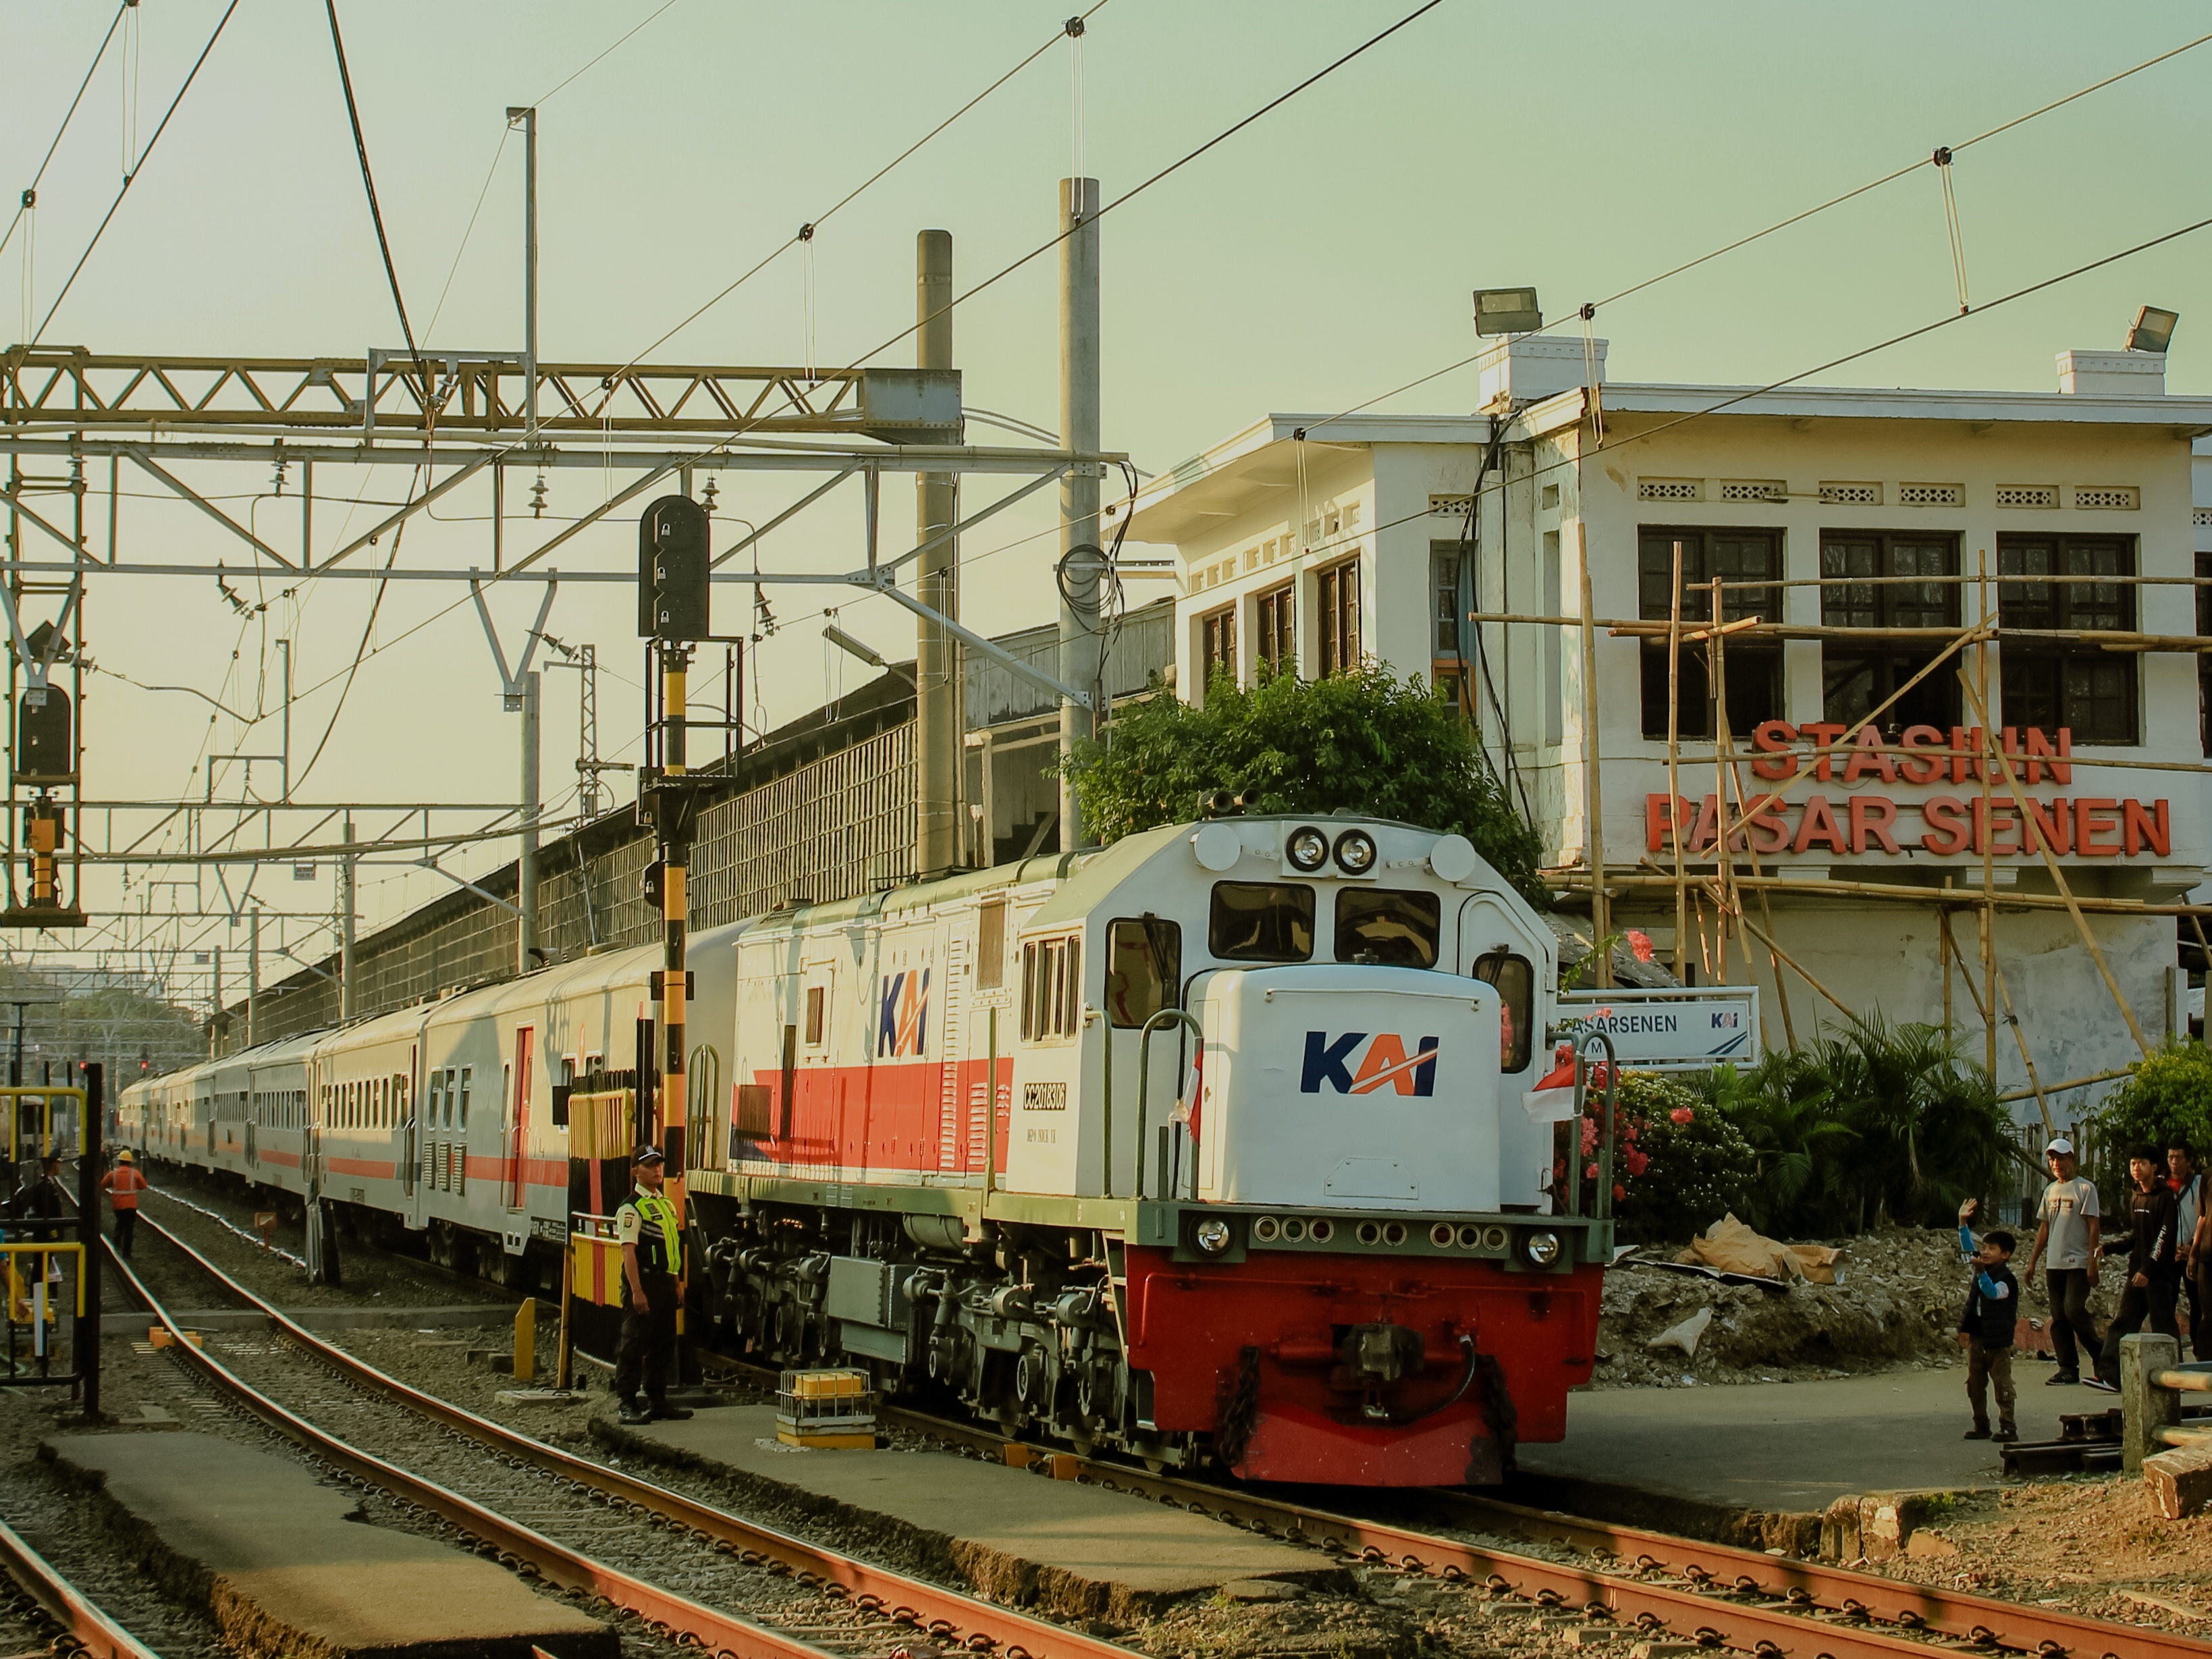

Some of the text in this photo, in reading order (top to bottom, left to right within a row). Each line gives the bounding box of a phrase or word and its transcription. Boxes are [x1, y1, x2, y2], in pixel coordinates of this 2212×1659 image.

[1751, 719, 2072, 785] STASIUN
[1645, 792, 2171, 856] PASAR SENEN
[877, 967, 930, 1058] KAI
[1711, 1012, 1738, 1029] KAI
[1300, 1031, 1439, 1097] KAI
